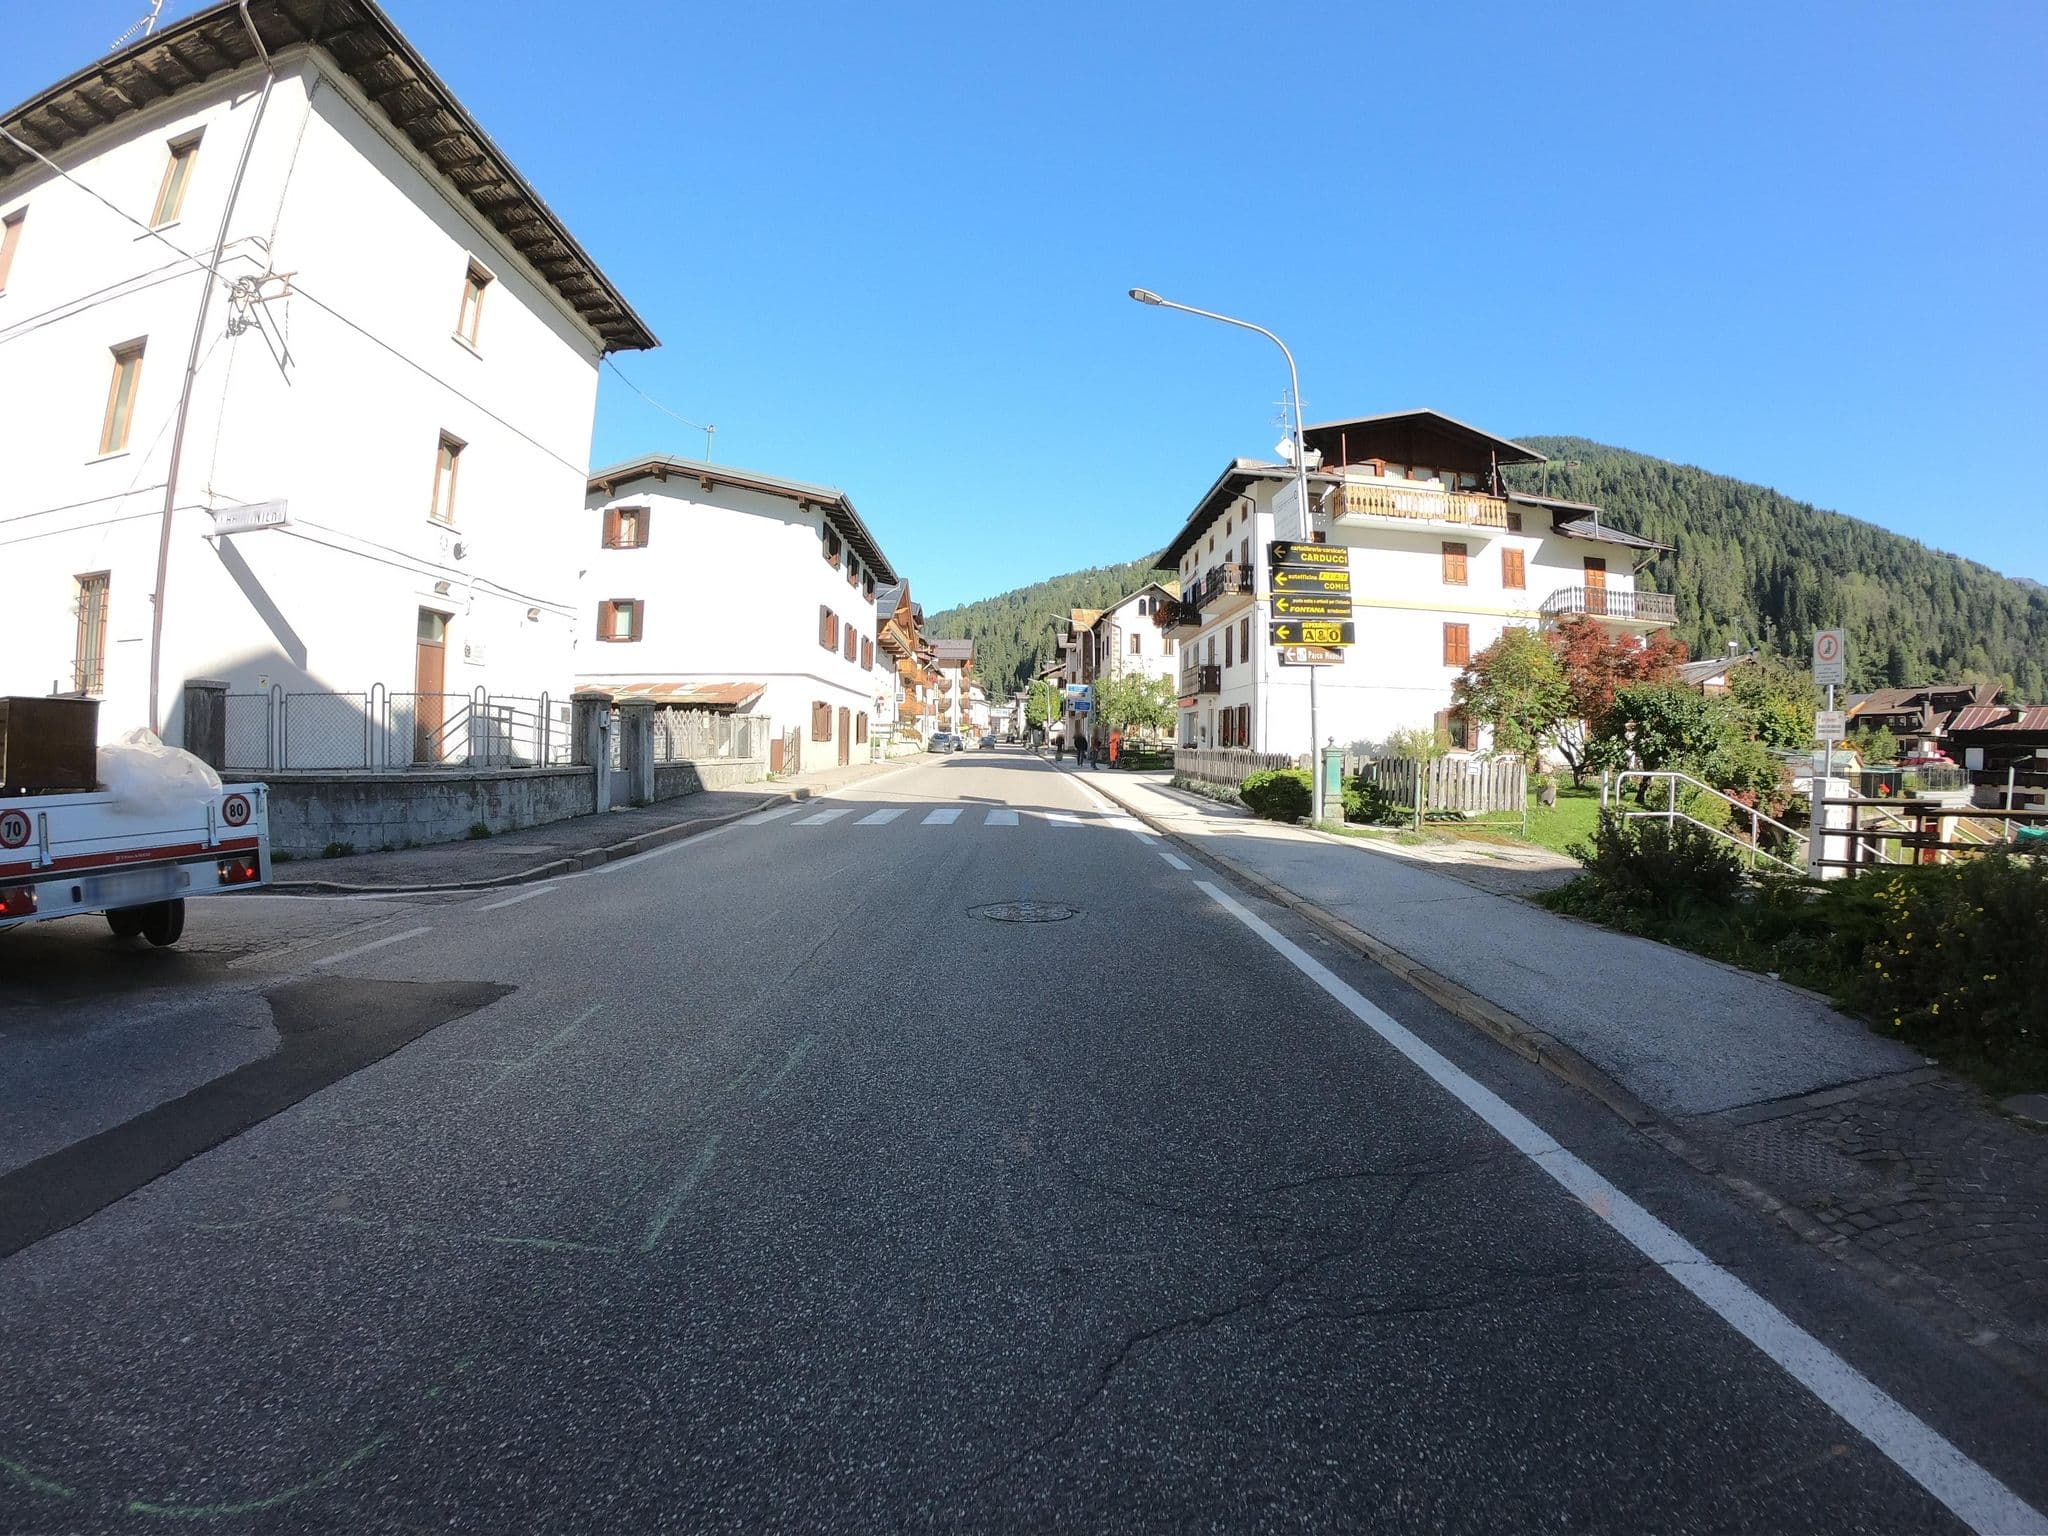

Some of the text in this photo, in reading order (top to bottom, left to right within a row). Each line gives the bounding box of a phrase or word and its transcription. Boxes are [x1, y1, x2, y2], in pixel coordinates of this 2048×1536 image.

[1301, 553, 1348, 564] CARDUCCI
[1324, 582, 1350, 591] COMIS
[1289, 606, 1325, 614] FONTANA
[230, 803, 243, 817] 80
[5, 821, 21, 837] 70
